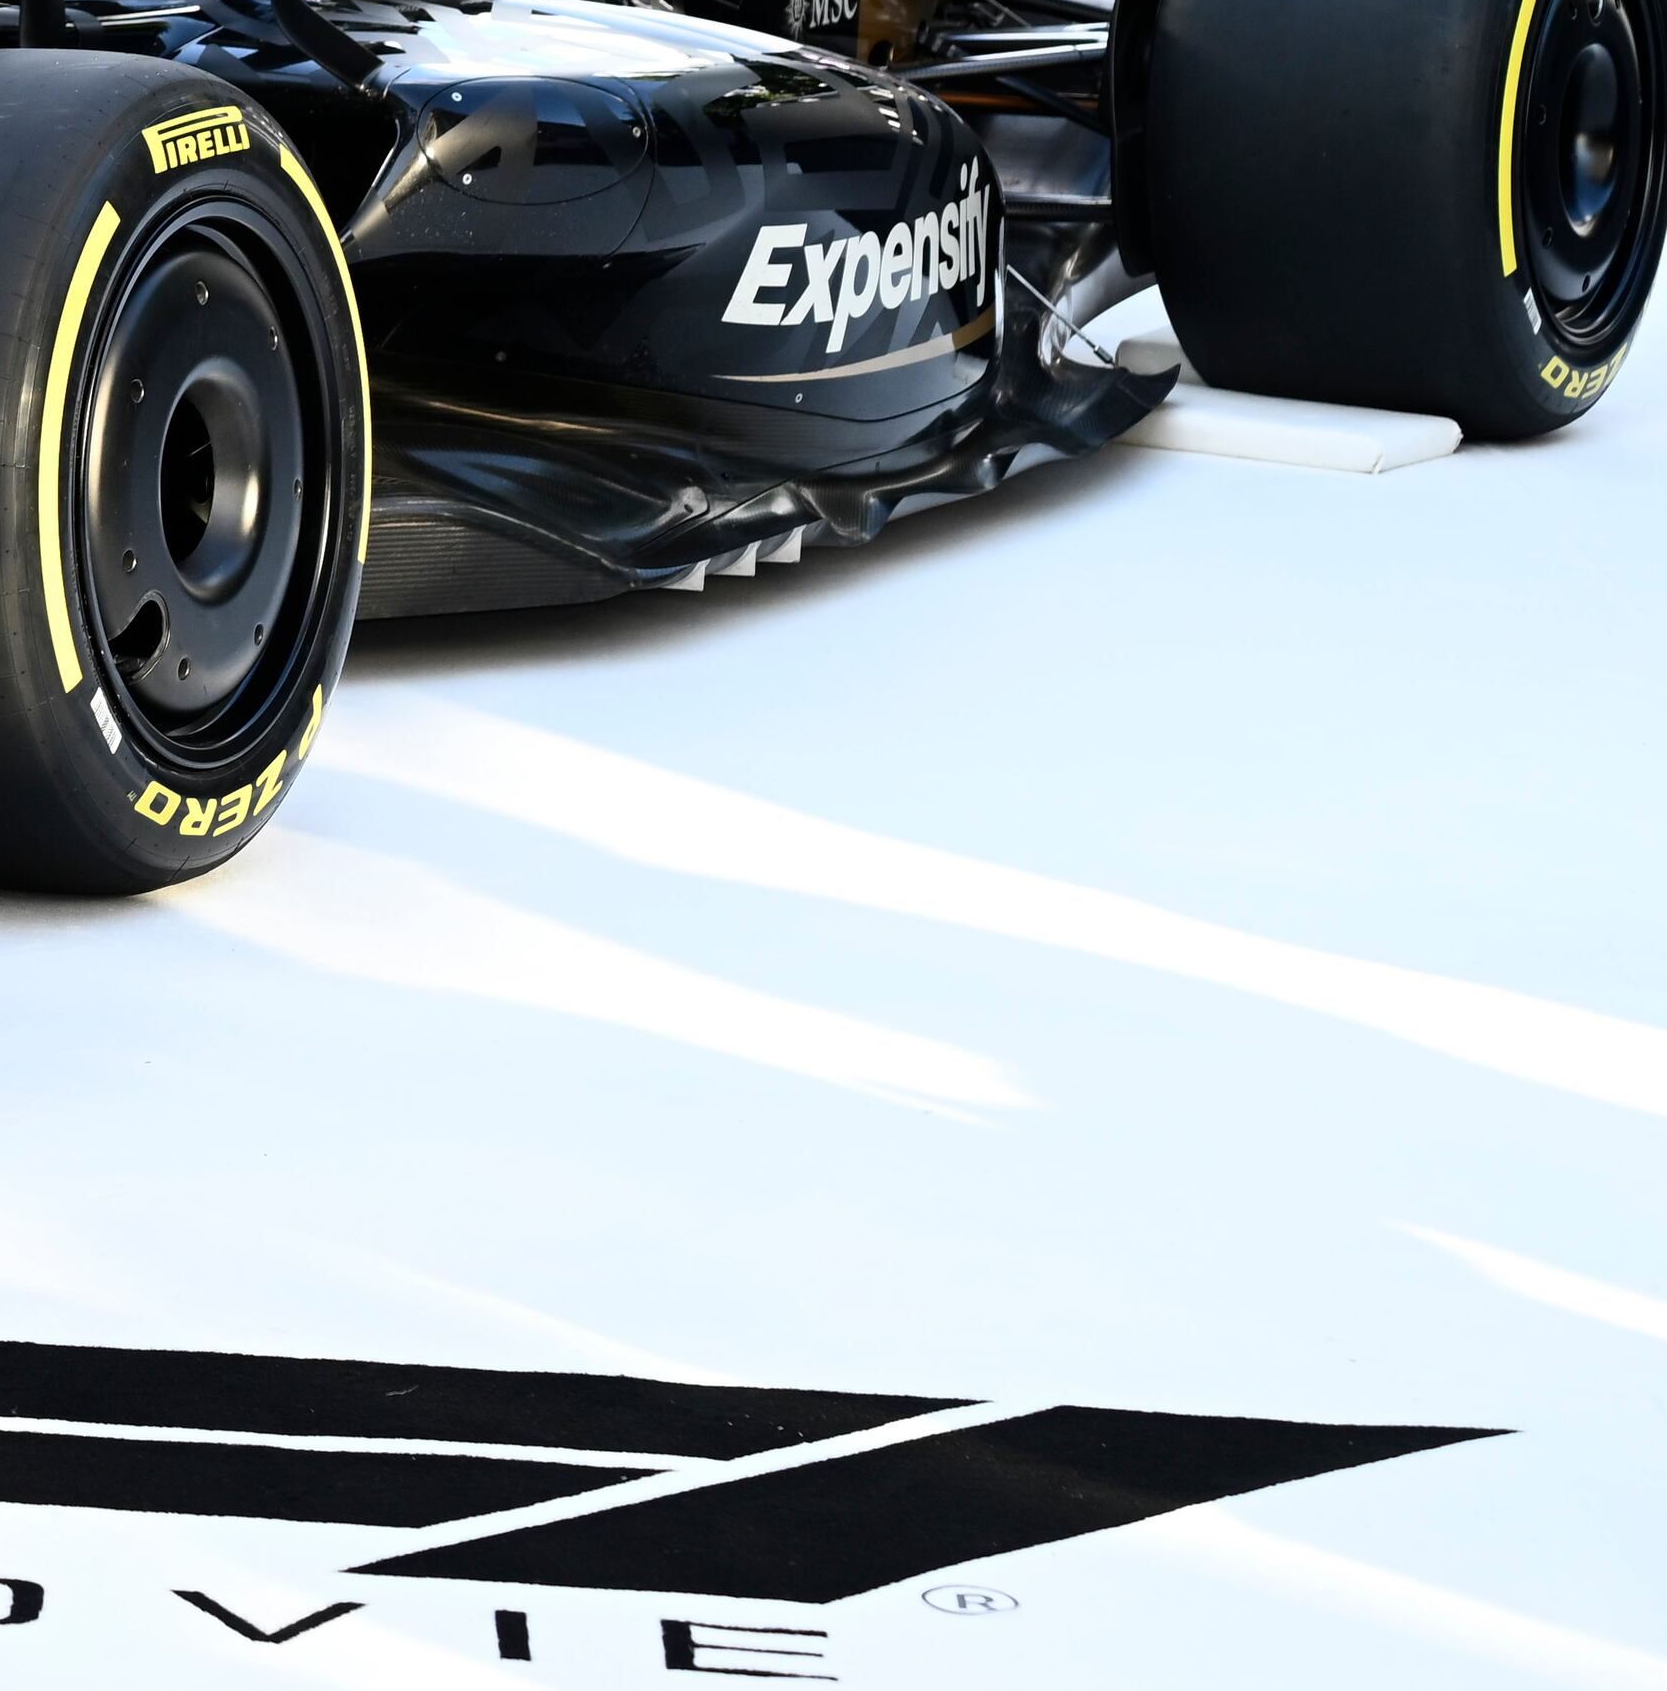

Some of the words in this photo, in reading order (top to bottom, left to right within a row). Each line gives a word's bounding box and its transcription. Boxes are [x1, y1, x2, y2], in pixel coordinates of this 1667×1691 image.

[142, 105, 251, 173] PIRELLI
[721, 155, 991, 354] Expensify
[134, 749, 288, 838] ZERO
